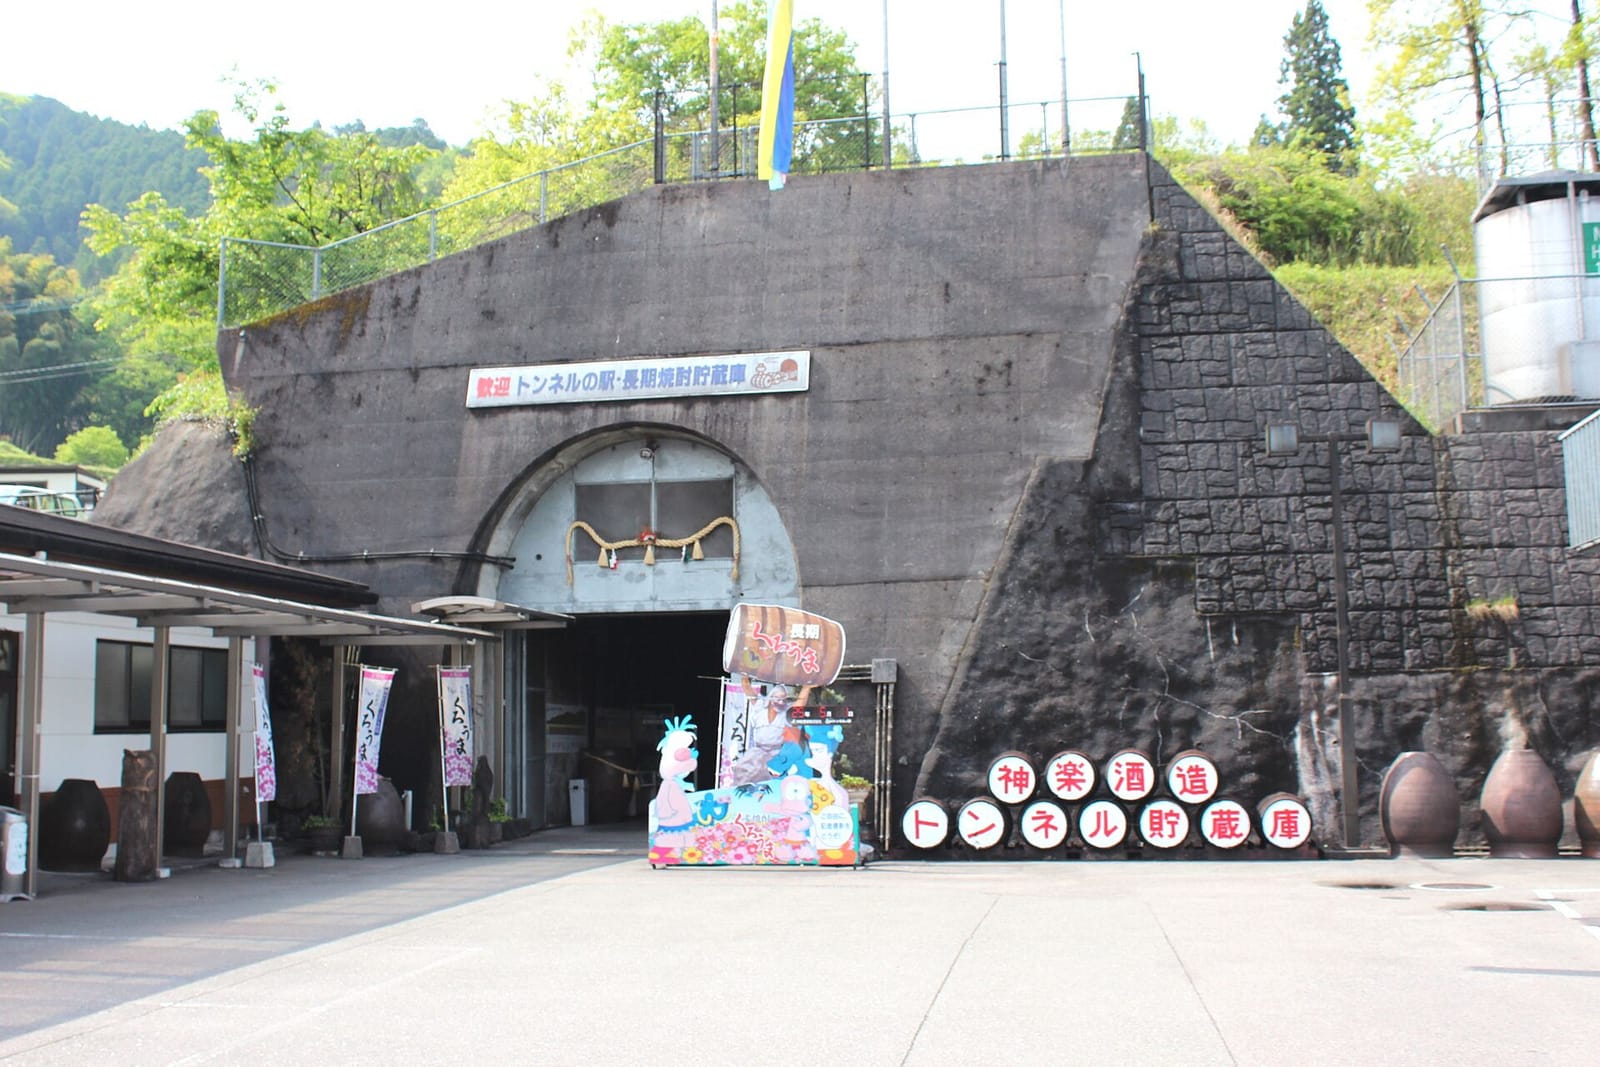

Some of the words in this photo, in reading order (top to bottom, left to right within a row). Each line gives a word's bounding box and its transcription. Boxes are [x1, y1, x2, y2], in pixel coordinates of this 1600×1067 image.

[752, 621, 820, 674] くろうま
[790, 624, 820, 640] 長期
[361, 699, 376, 761] くろうま
[452, 697, 470, 755] くろうま
[998, 761, 1209, 796] 神楽酒造
[735, 813, 774, 859] くろうま
[914, 808, 1300, 840] トンネル貯蔵庫
